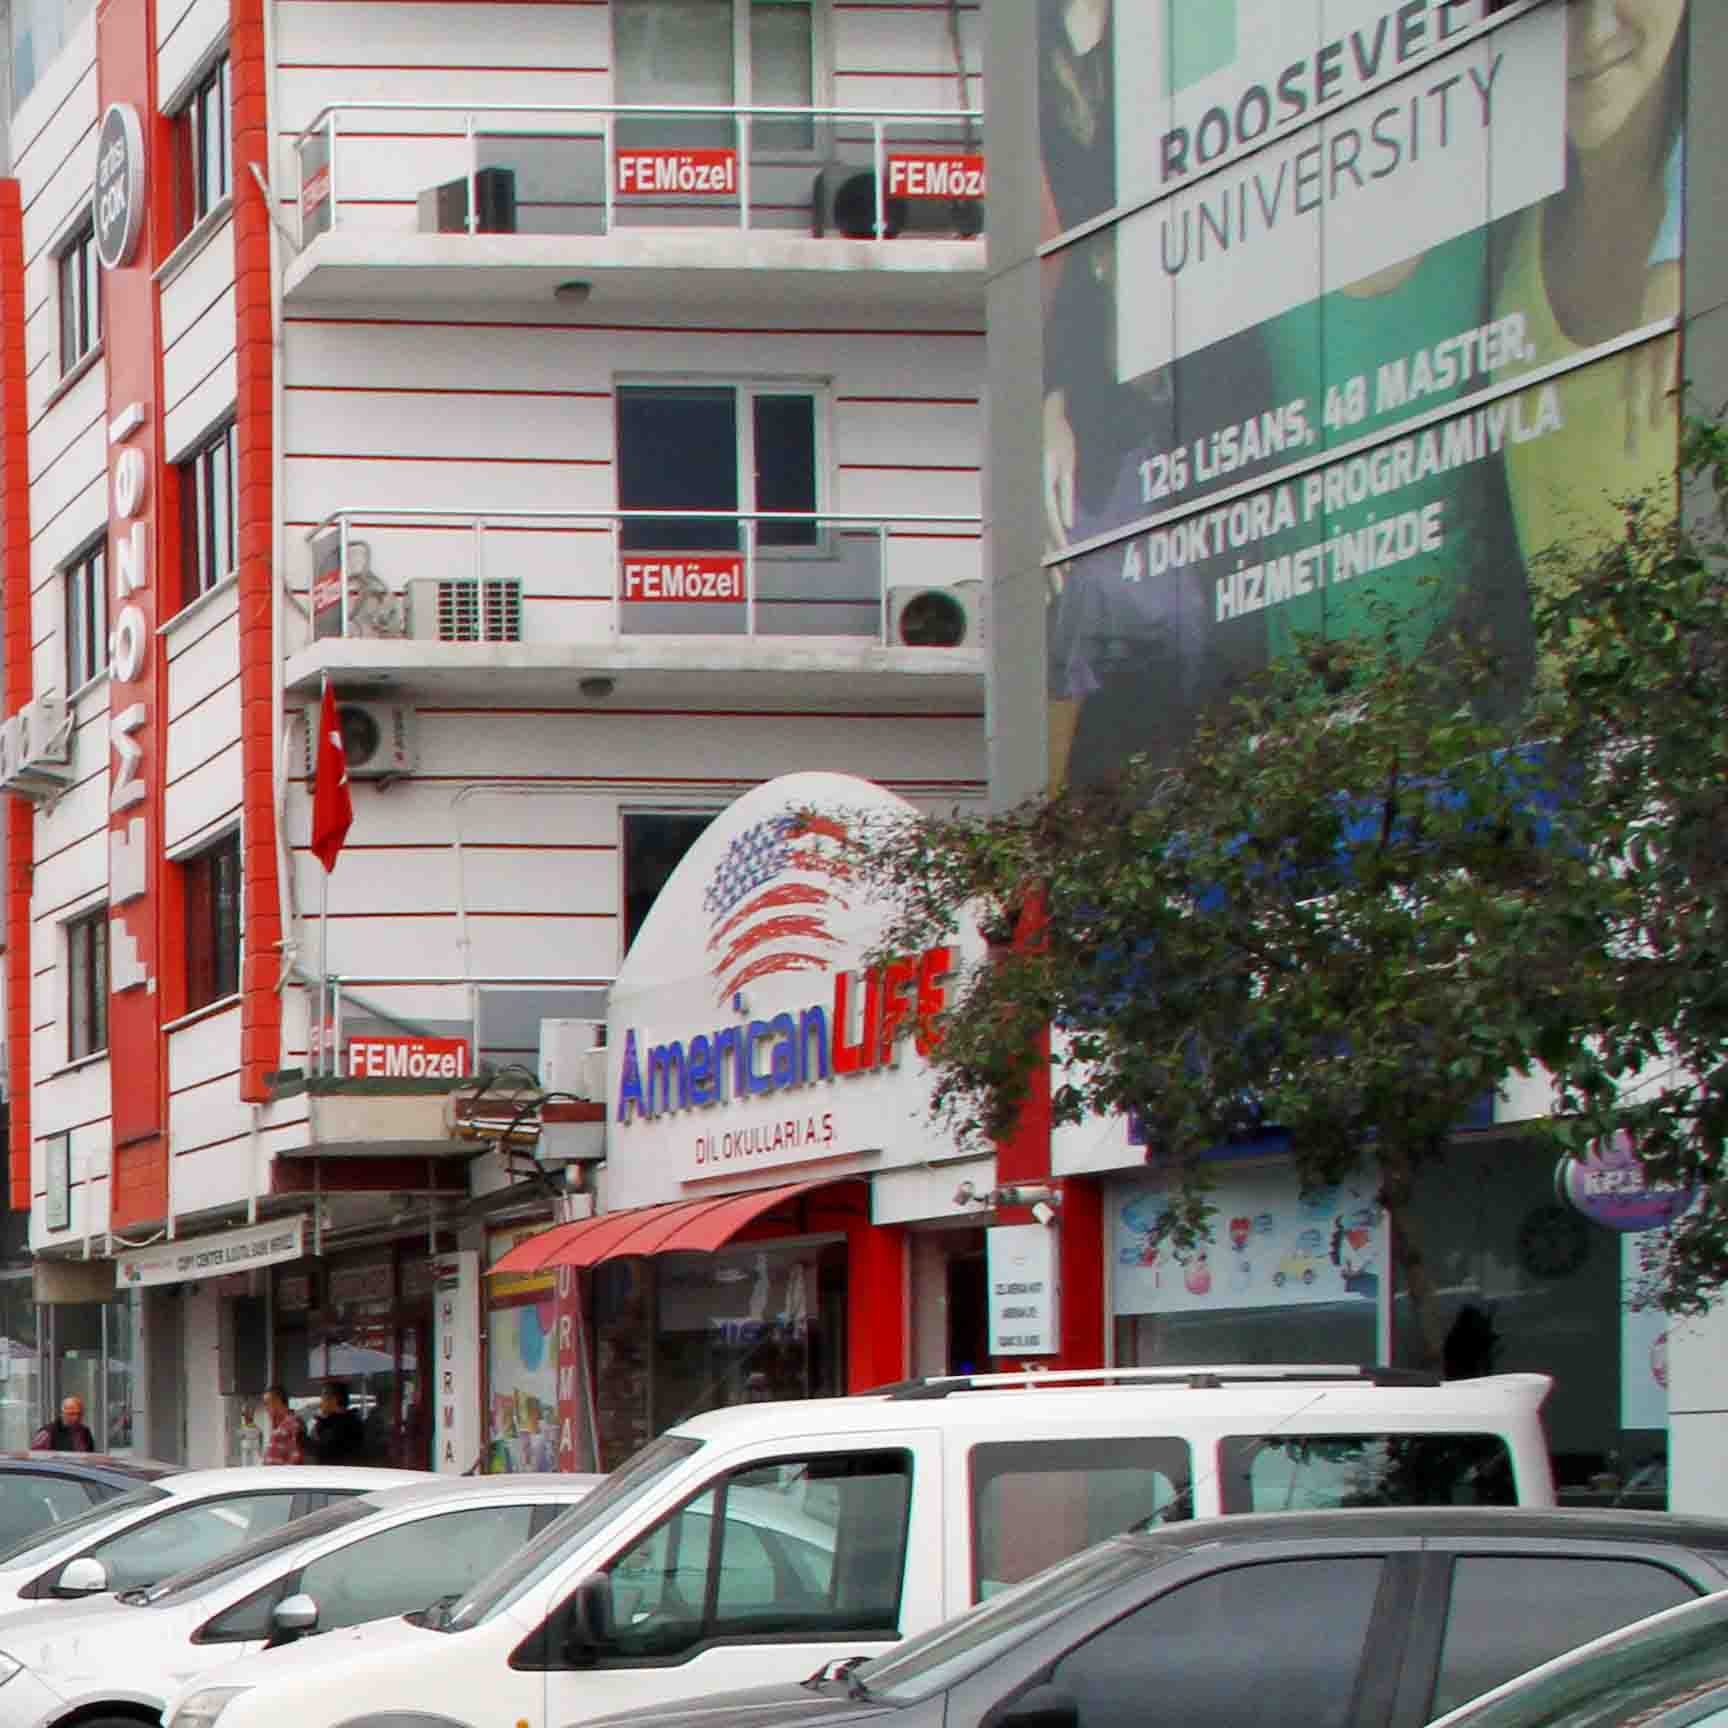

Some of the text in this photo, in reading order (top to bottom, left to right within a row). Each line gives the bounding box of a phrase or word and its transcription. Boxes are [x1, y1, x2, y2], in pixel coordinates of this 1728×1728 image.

[1161, 0, 1492, 182] ROOSEVEL
[618, 157, 733, 191] FEMözel
[889, 161, 984, 195] FEMöz
[1161, 54, 1503, 276] UNIVERSITY
[1139, 446, 1188, 503] 126
[1376, 312, 1536, 414] MASTER,
[1122, 384, 1563, 583] 4 DOKTORA PROGRAMIYLA
[625, 562, 740, 597] FEMözel
[1216, 502, 1446, 623] HİZMETİNİZDE
[349, 1043, 465, 1077] FEMözel
[723, 1116, 802, 1159] OKULLARI
